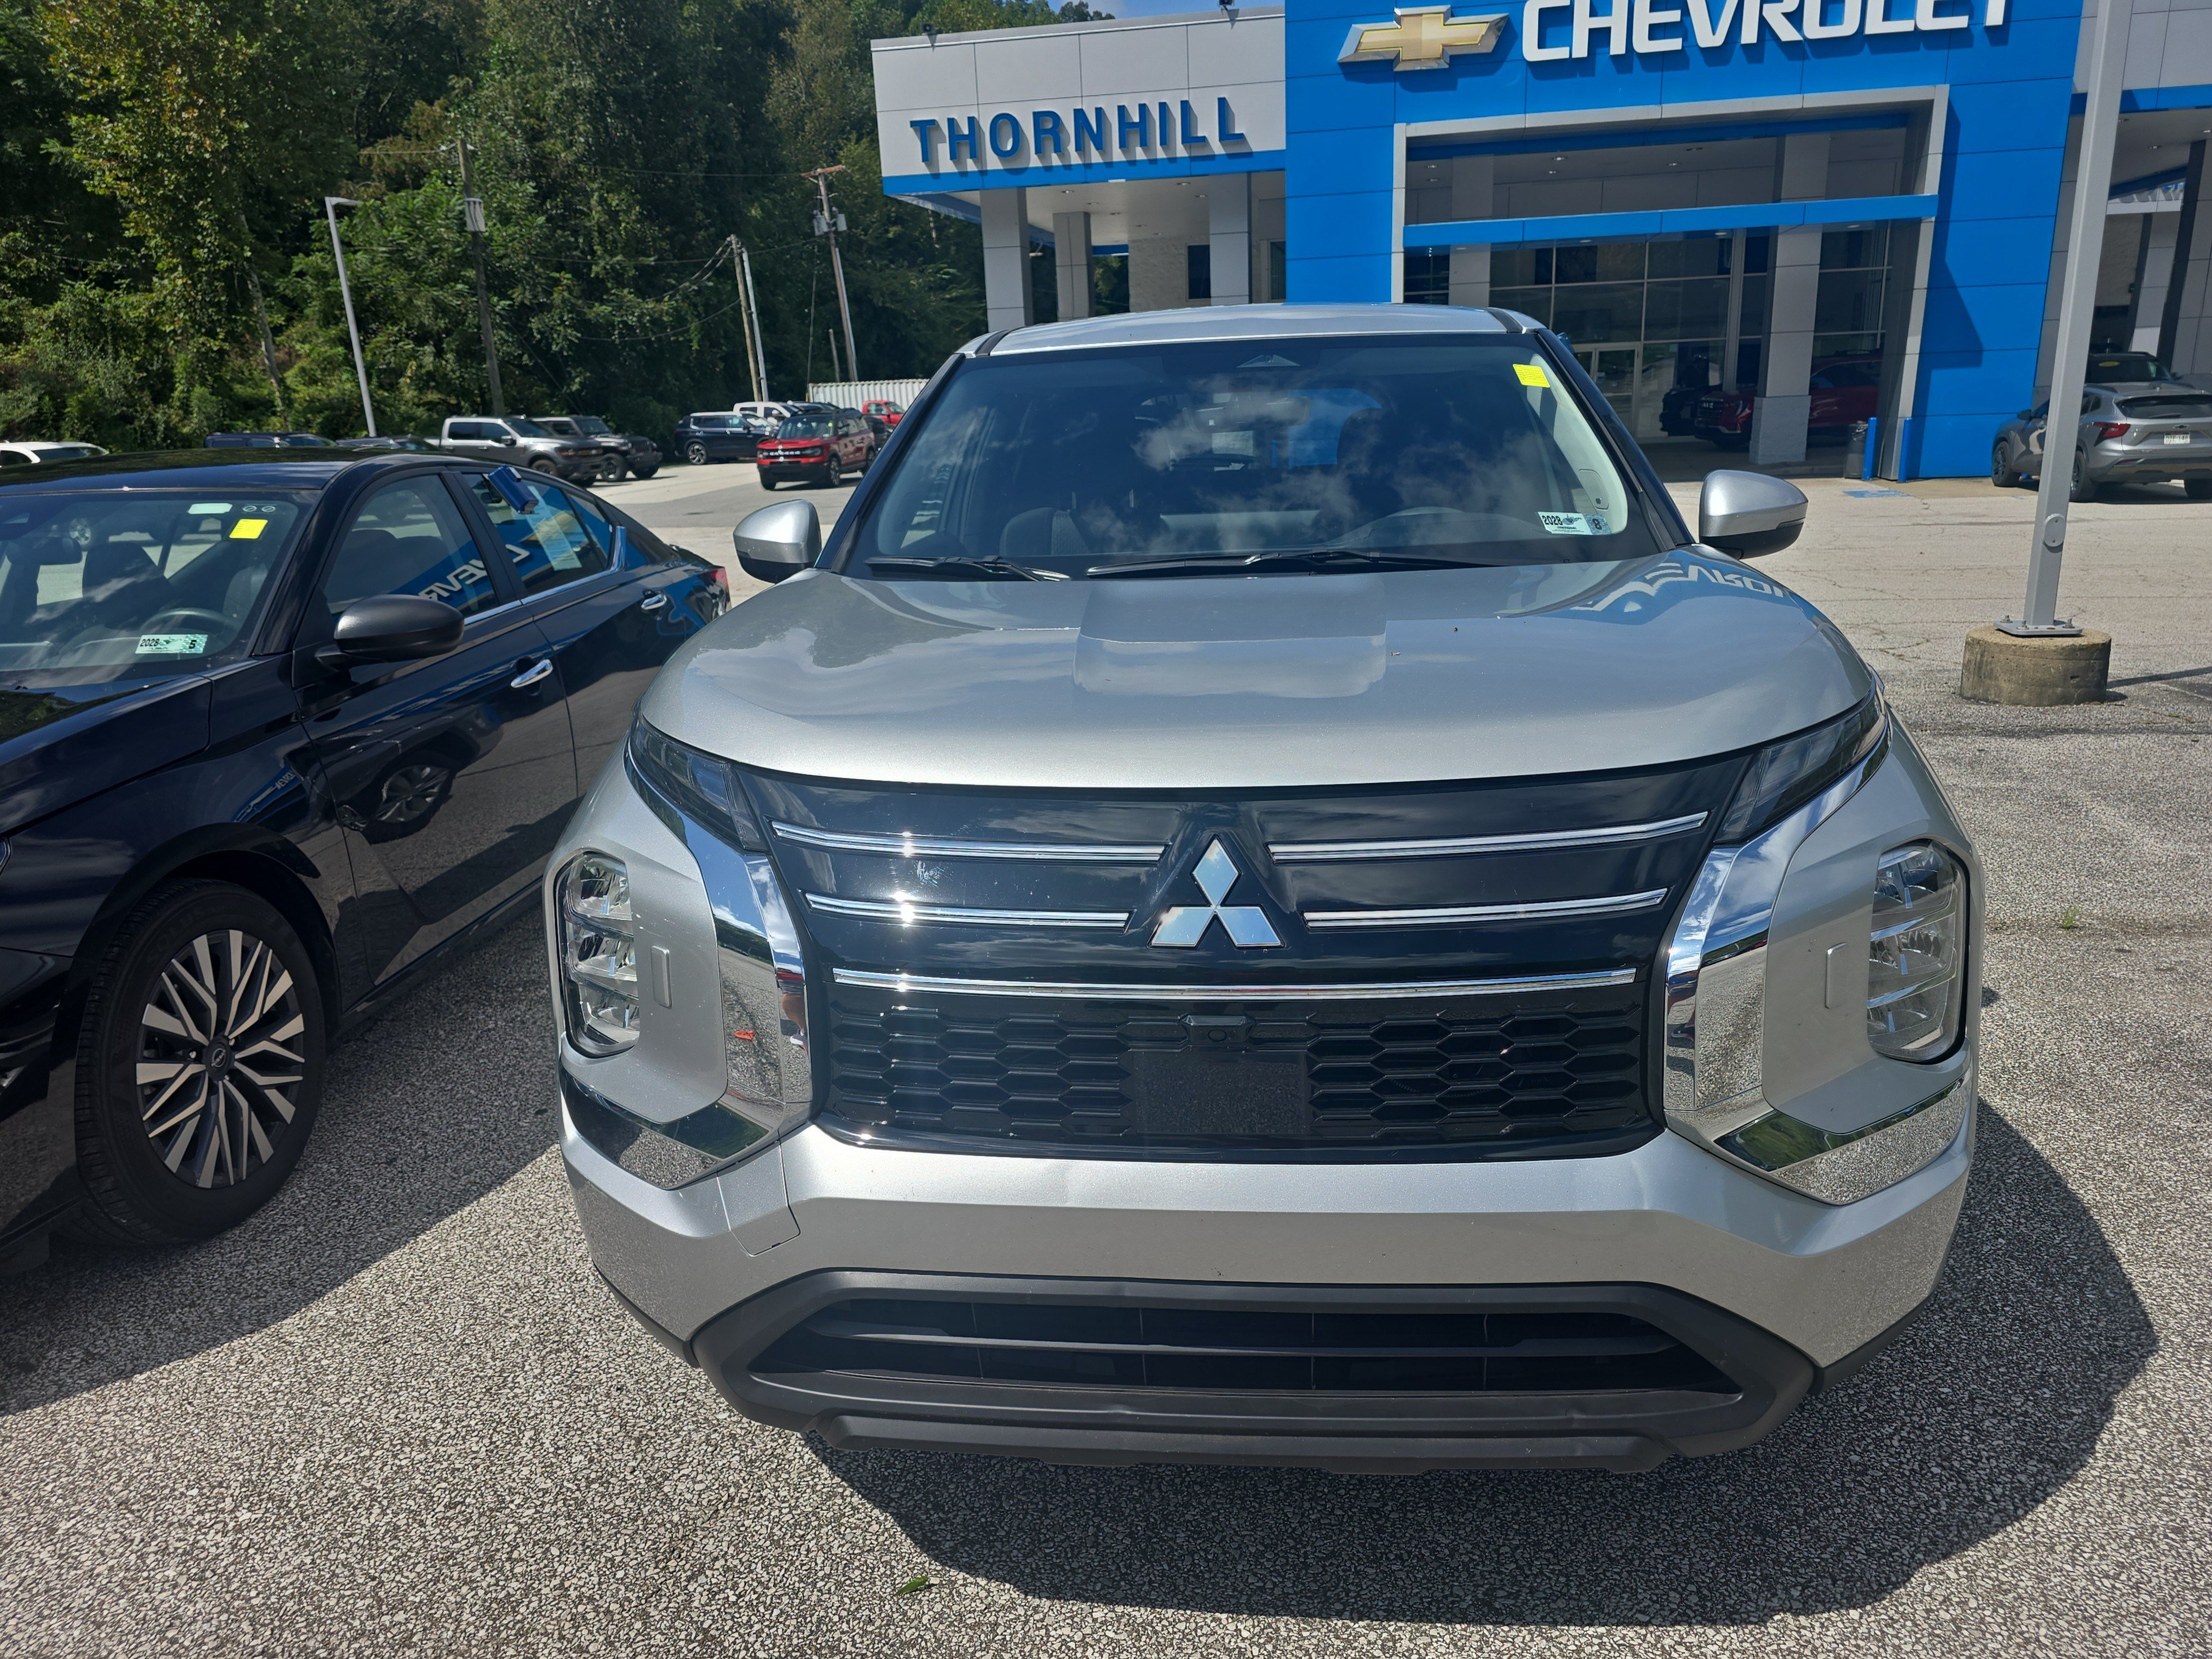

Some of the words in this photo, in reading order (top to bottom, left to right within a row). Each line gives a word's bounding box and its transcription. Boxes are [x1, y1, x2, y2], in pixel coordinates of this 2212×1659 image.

[910, 97, 1245, 163] THORNHILL
[1542, 516, 1563, 525] 2028
[1592, 518, 1602, 530] 8
[189, 639, 197, 649] 5
